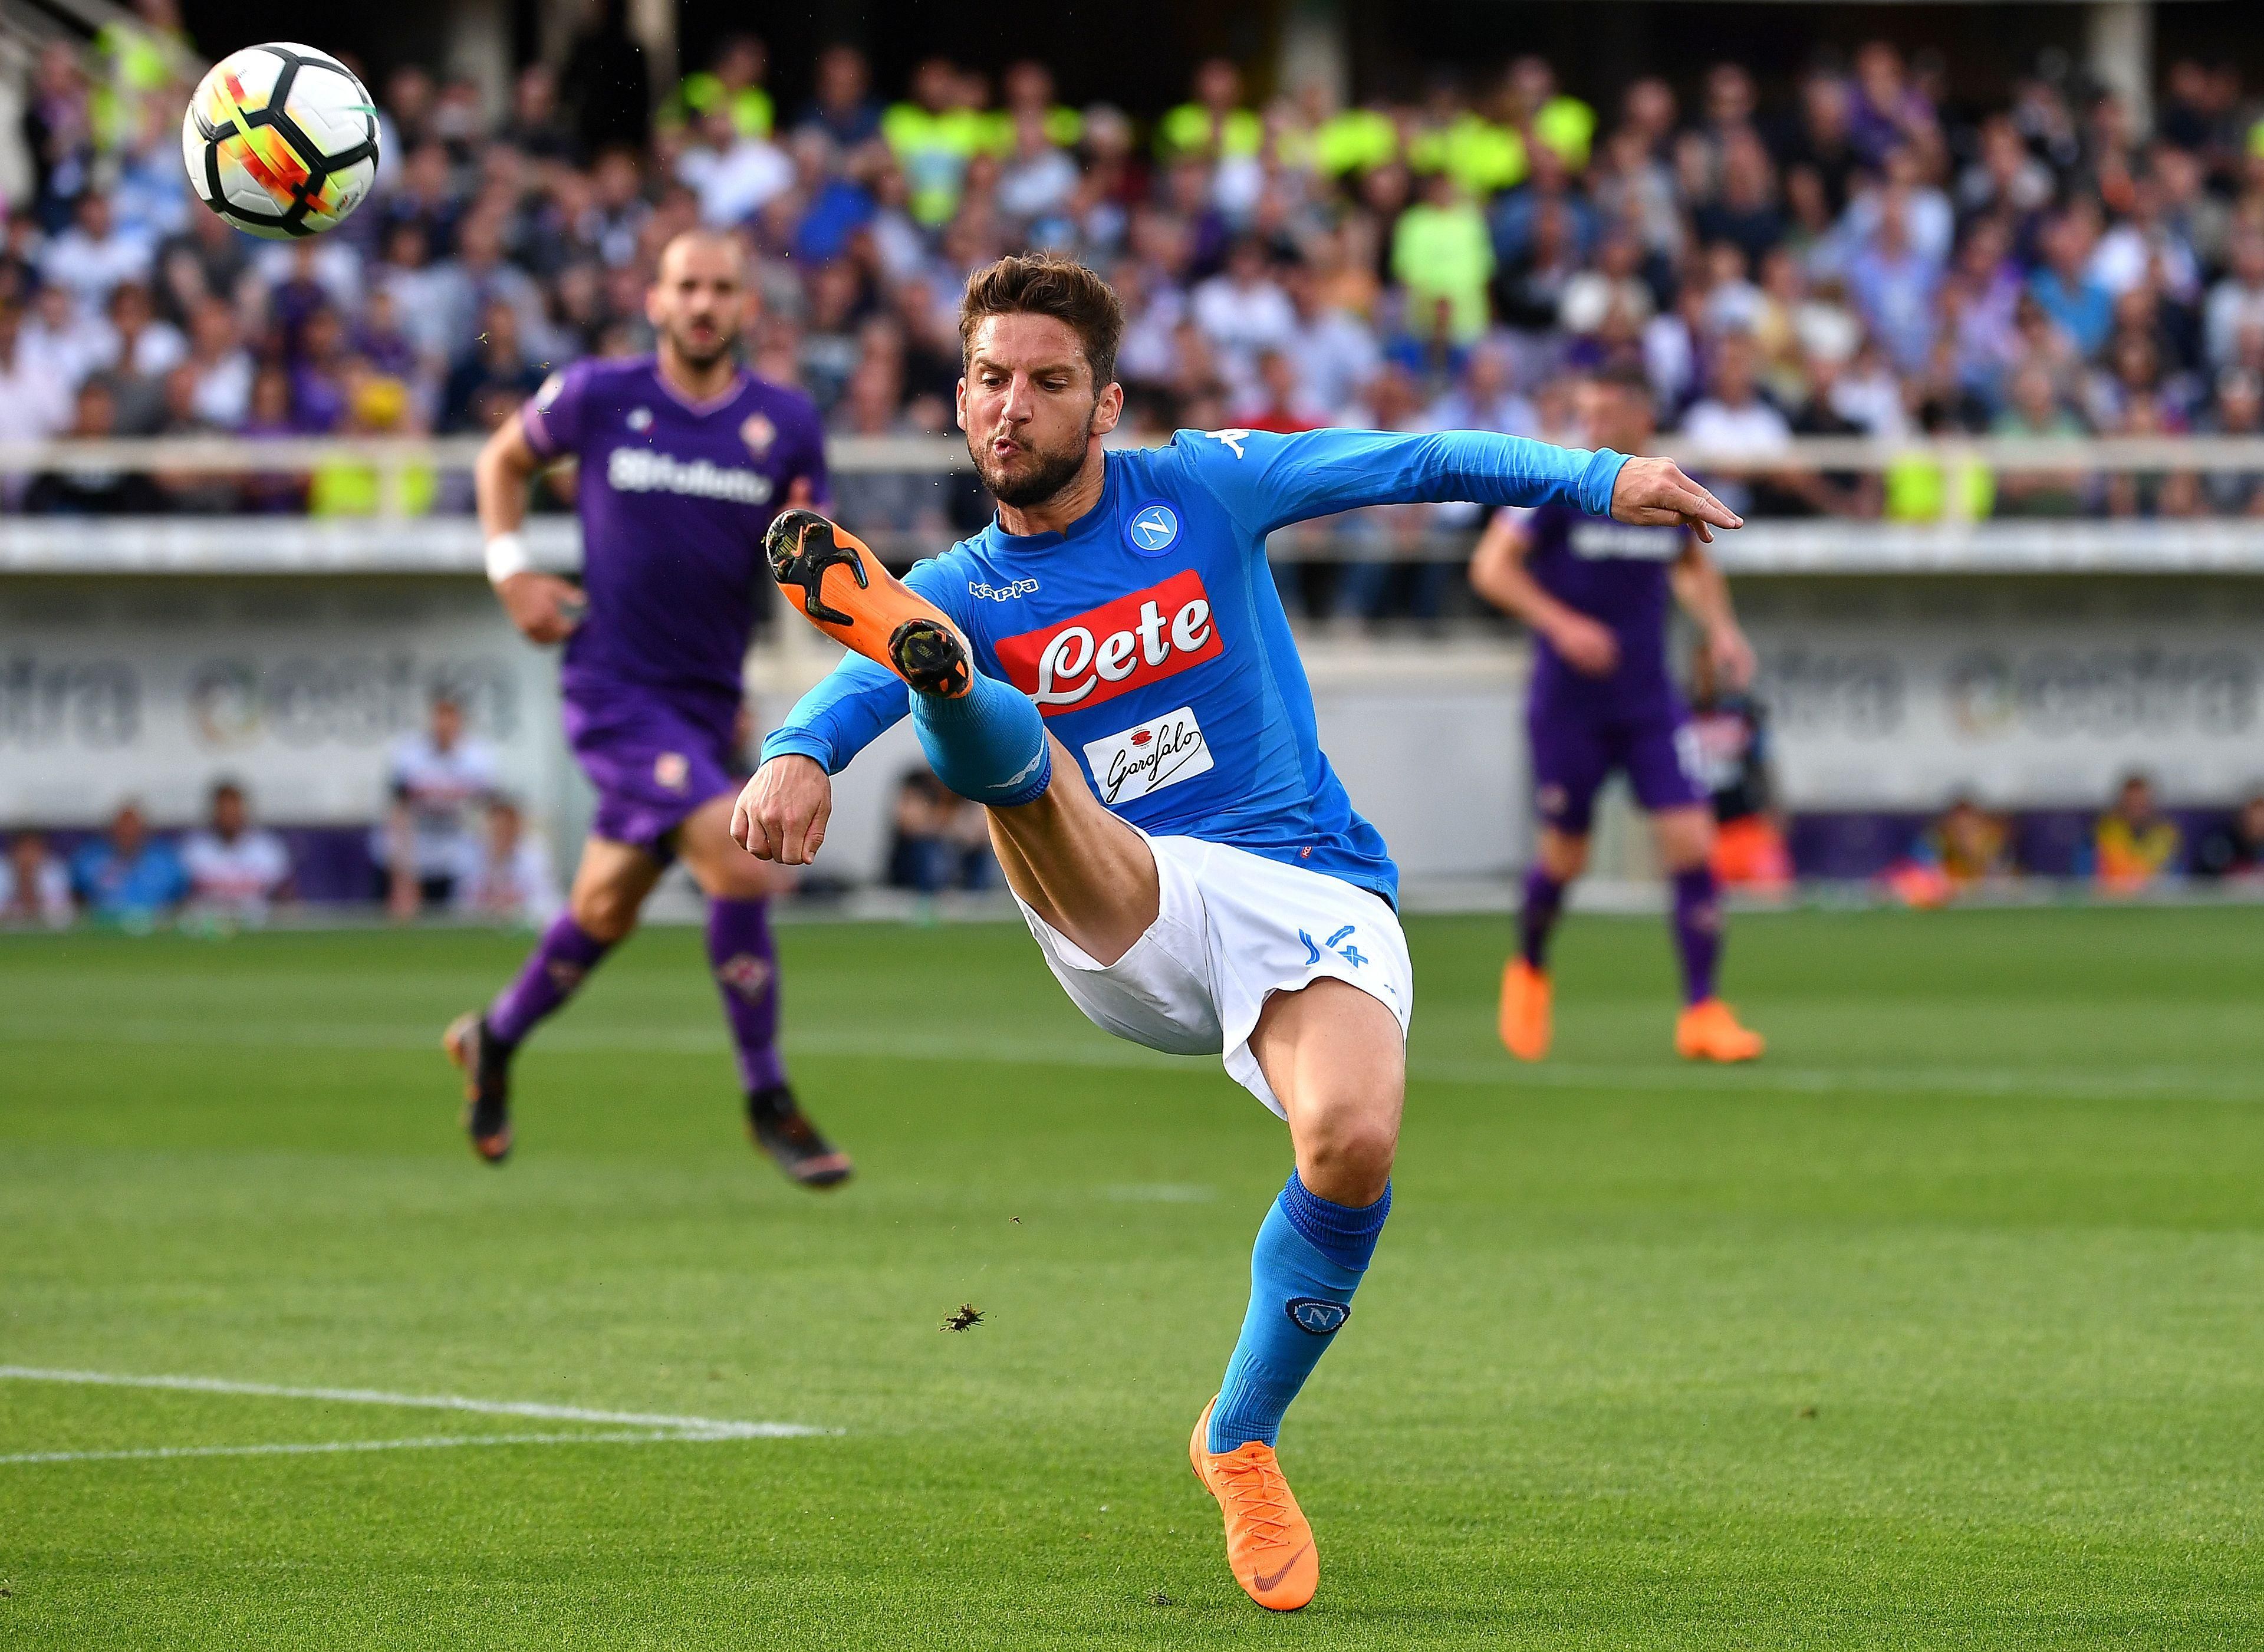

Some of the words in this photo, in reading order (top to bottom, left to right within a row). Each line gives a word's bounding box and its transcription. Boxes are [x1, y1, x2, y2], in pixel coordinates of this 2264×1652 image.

[1136, 510, 1170, 546] N
[1028, 599, 1212, 706] Lete
[1106, 720, 1202, 804] Garofalo
[1305, 1307, 1332, 1326] N
